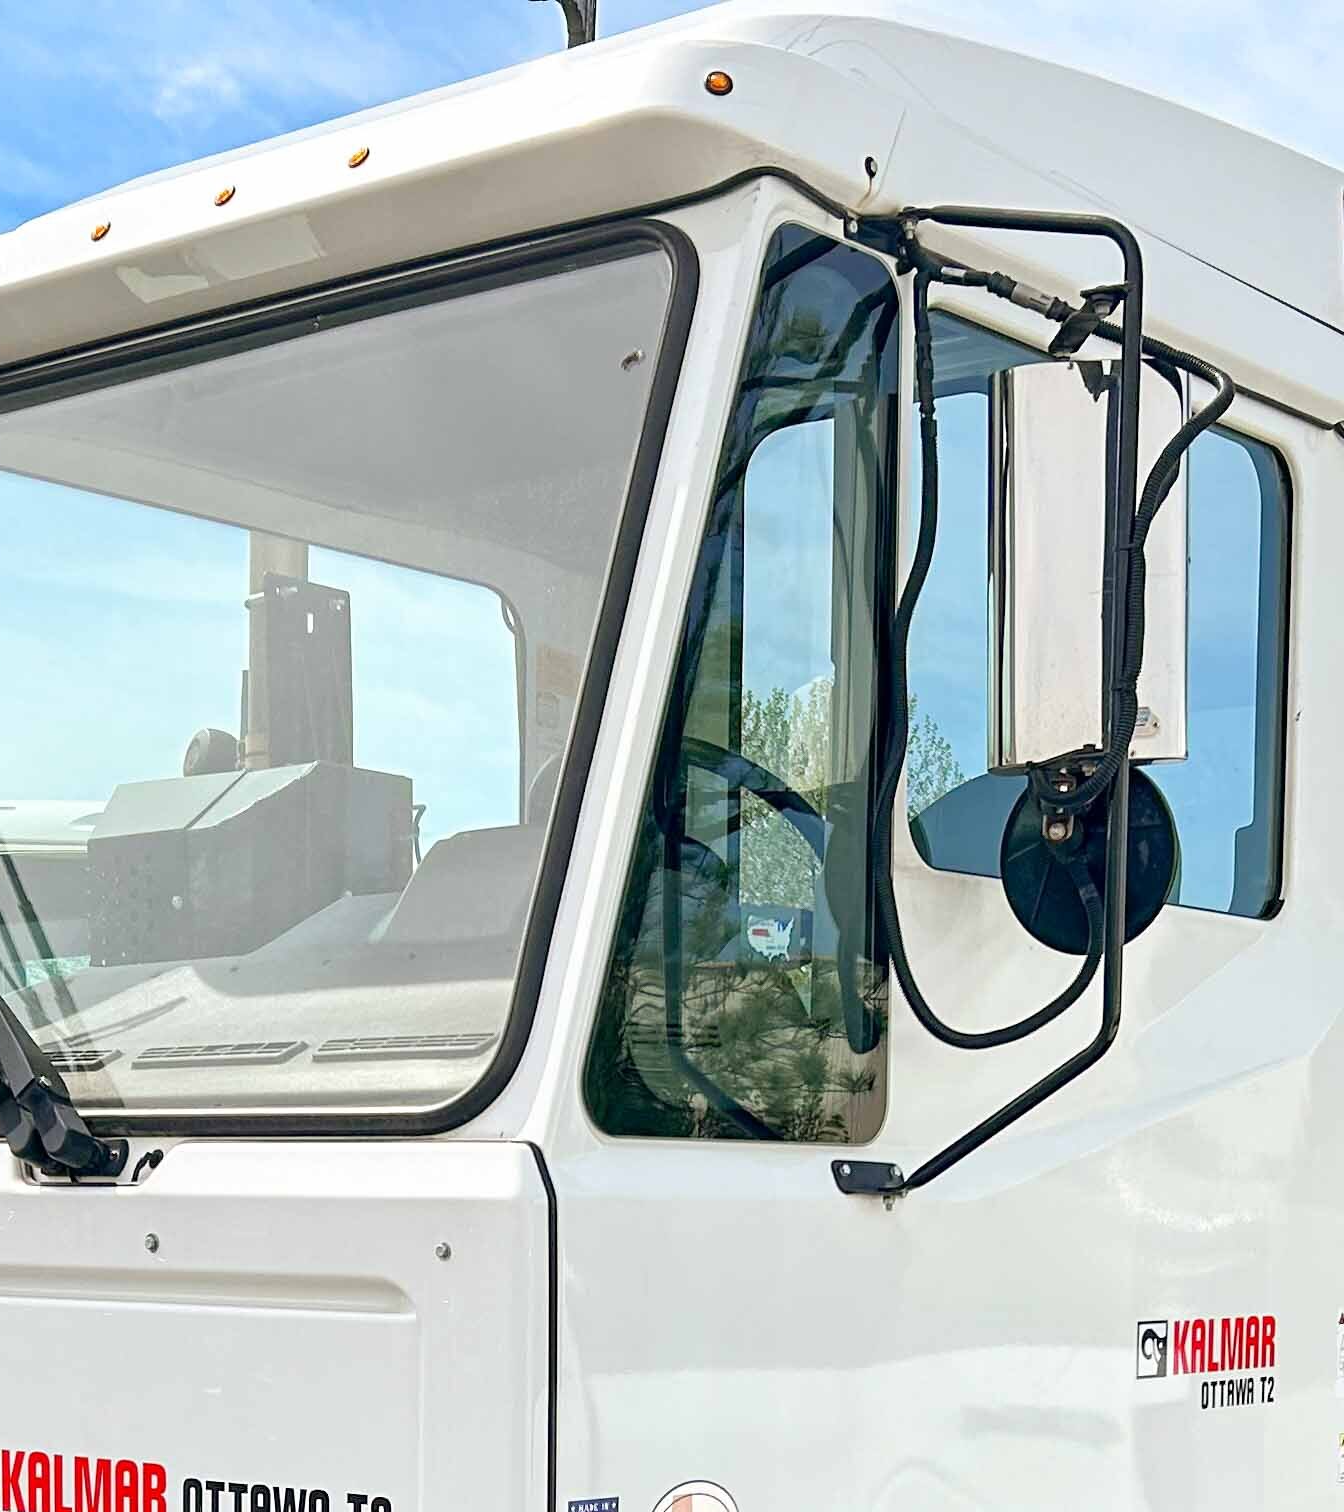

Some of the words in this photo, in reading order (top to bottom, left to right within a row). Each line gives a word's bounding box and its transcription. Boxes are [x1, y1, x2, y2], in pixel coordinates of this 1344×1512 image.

[1172, 1315, 1276, 1376] KALMAR
[1201, 1378, 1254, 1410] OTTAWA
[1260, 1376, 1275, 1403] T2
